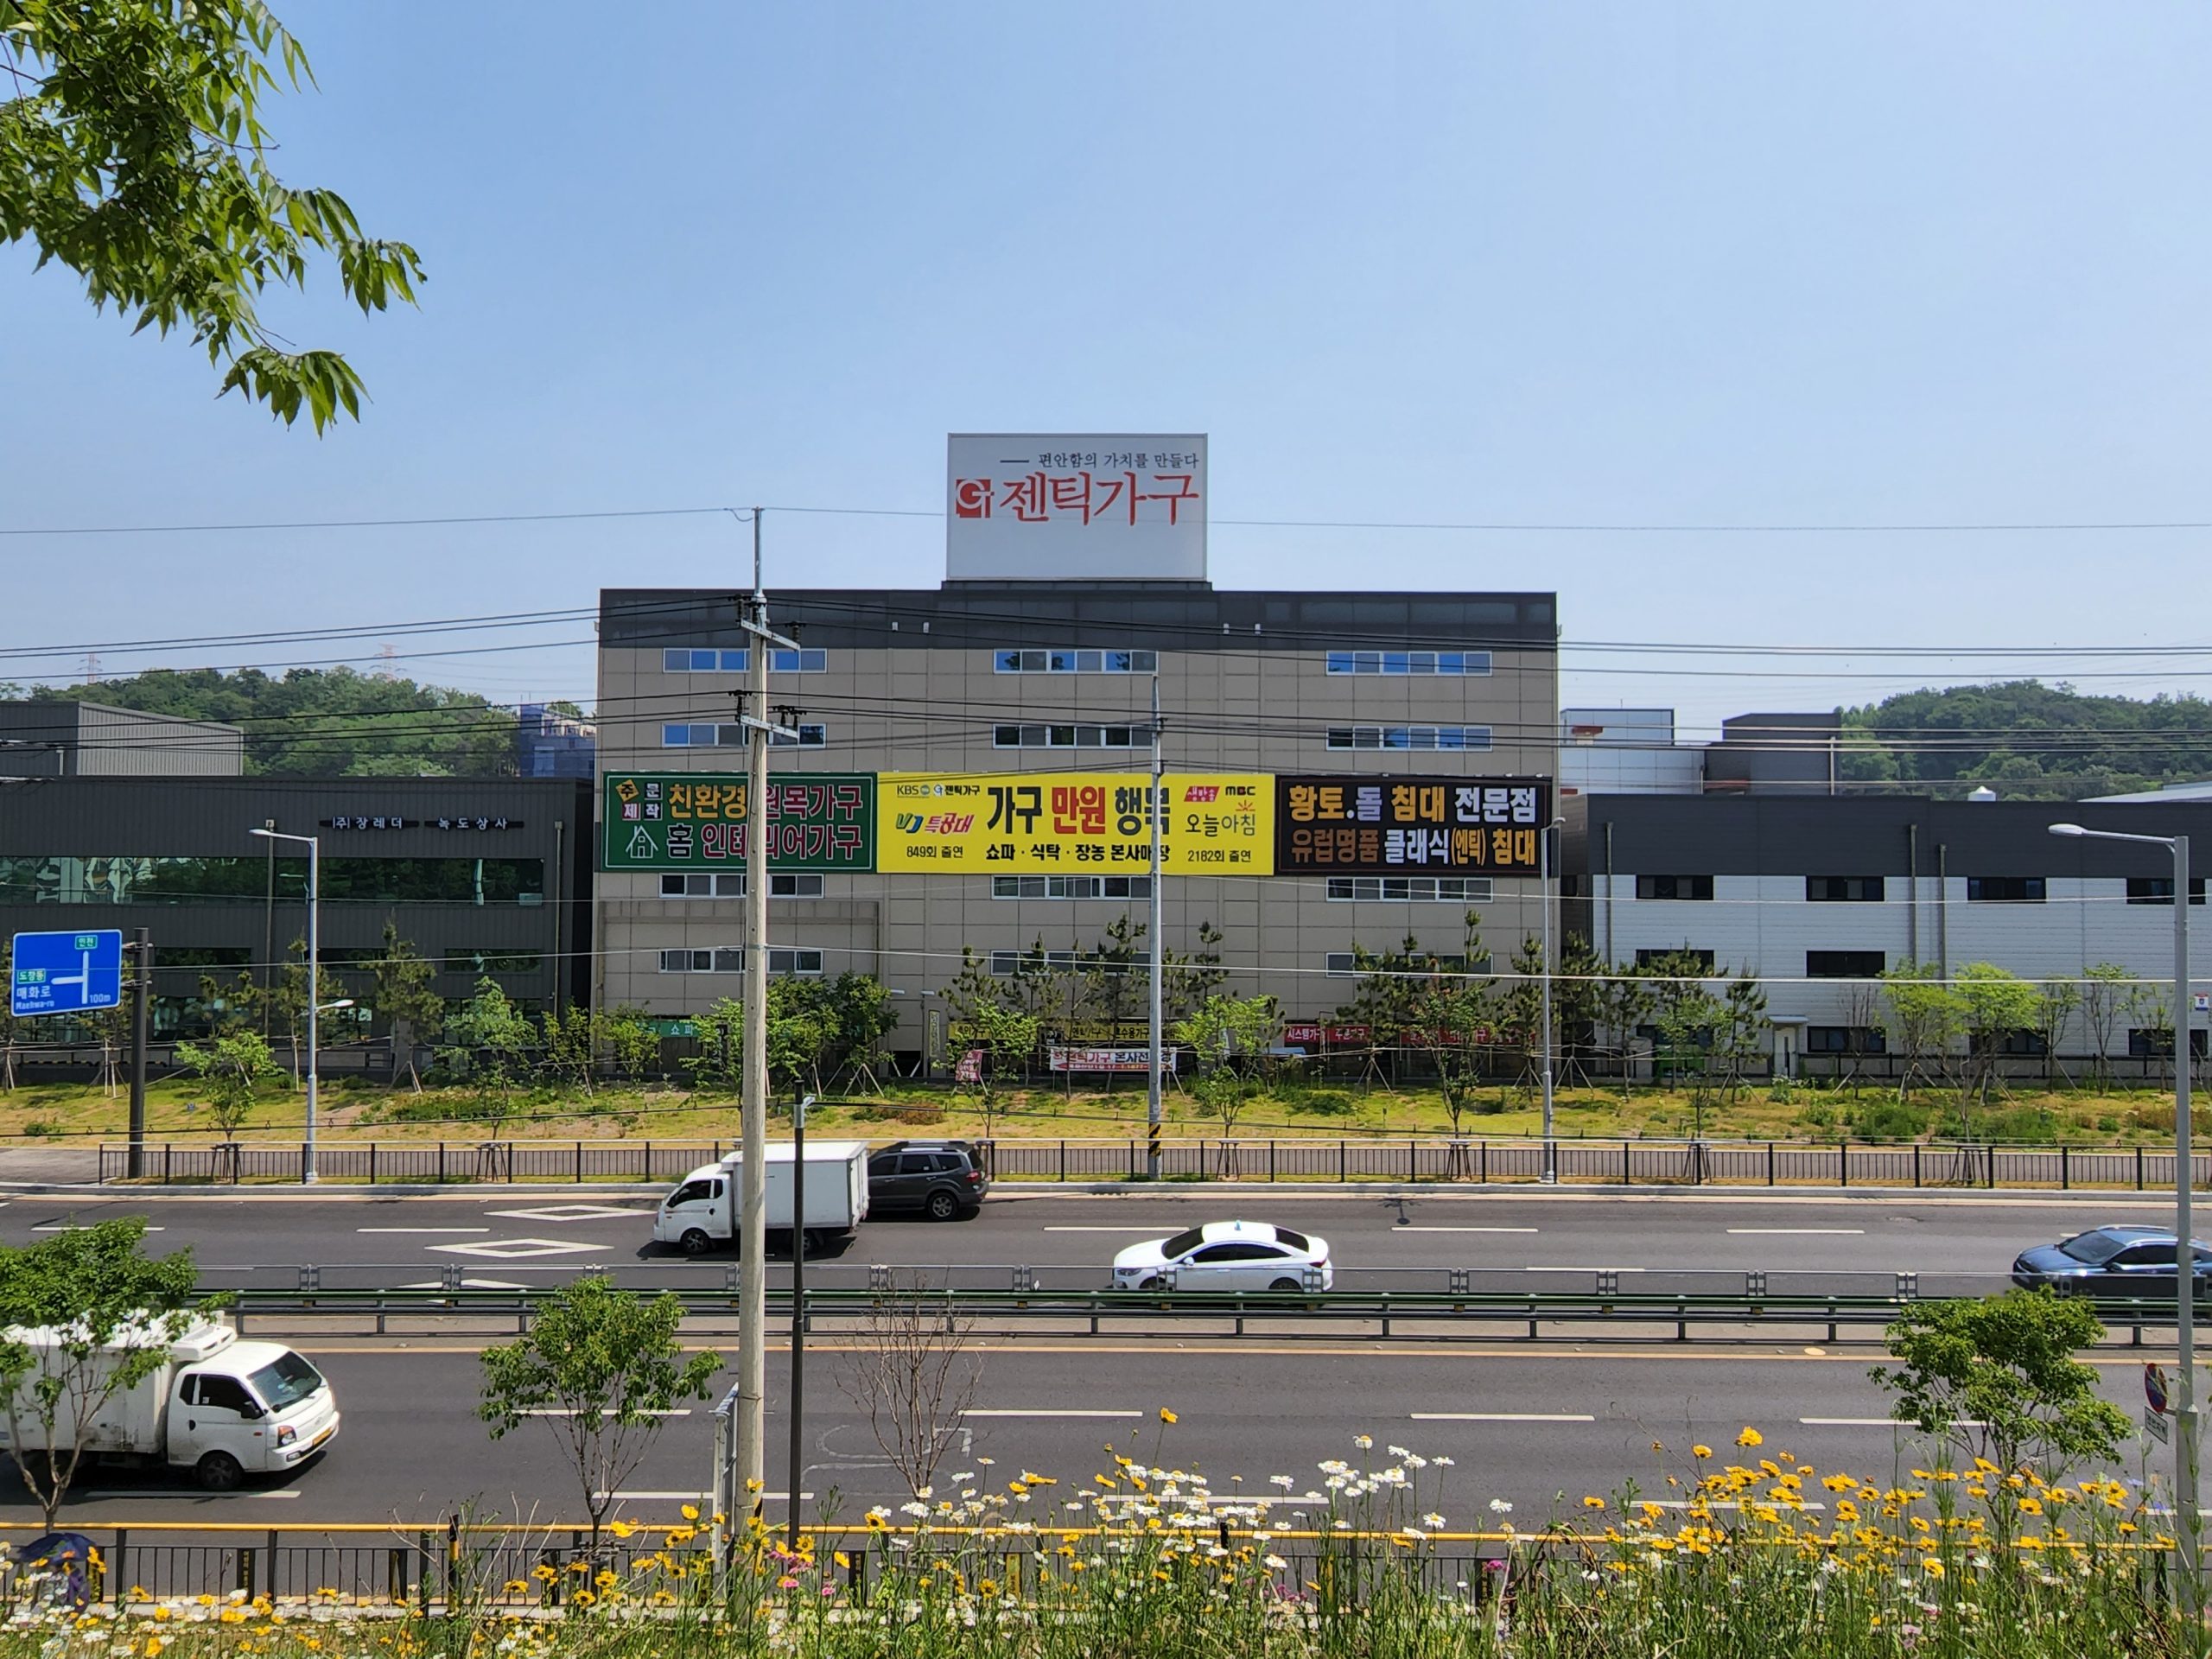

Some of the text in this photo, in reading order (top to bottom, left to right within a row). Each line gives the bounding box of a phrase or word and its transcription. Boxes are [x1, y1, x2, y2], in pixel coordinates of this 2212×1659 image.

[1038, 453, 1199, 468] 편안함의 가치를 만들다
[1000, 471, 1199, 525] 젠틱가구
[897, 785, 919, 795] KBS
[1186, 786, 1216, 802] 생방송
[669, 784, 748, 819] 친환경
[986, 786, 1042, 834] 가구
[1052, 786, 1106, 835] 만원
[1391, 785, 1445, 822] 침대
[1454, 786, 1536, 823] 전문점
[896, 812, 975, 835] VJ 특공대
[1185, 814, 1255, 837] 오늘아침
[667, 823, 694, 859] 홈
[1291, 829, 1380, 863] 유럽명품
[1492, 829, 1535, 865] 침대
[906, 846, 963, 858] 849회 출연
[986, 844, 1016, 861] 쇼파
[1030, 843, 1060, 861] 식탁
[1075, 843, 1104, 861] 장농
[1188, 850, 1251, 862] 2182회 출연
[79, 937, 94, 947] 인천
[16, 985, 51, 1000] 매화로
[89, 995, 111, 1003] 100m
